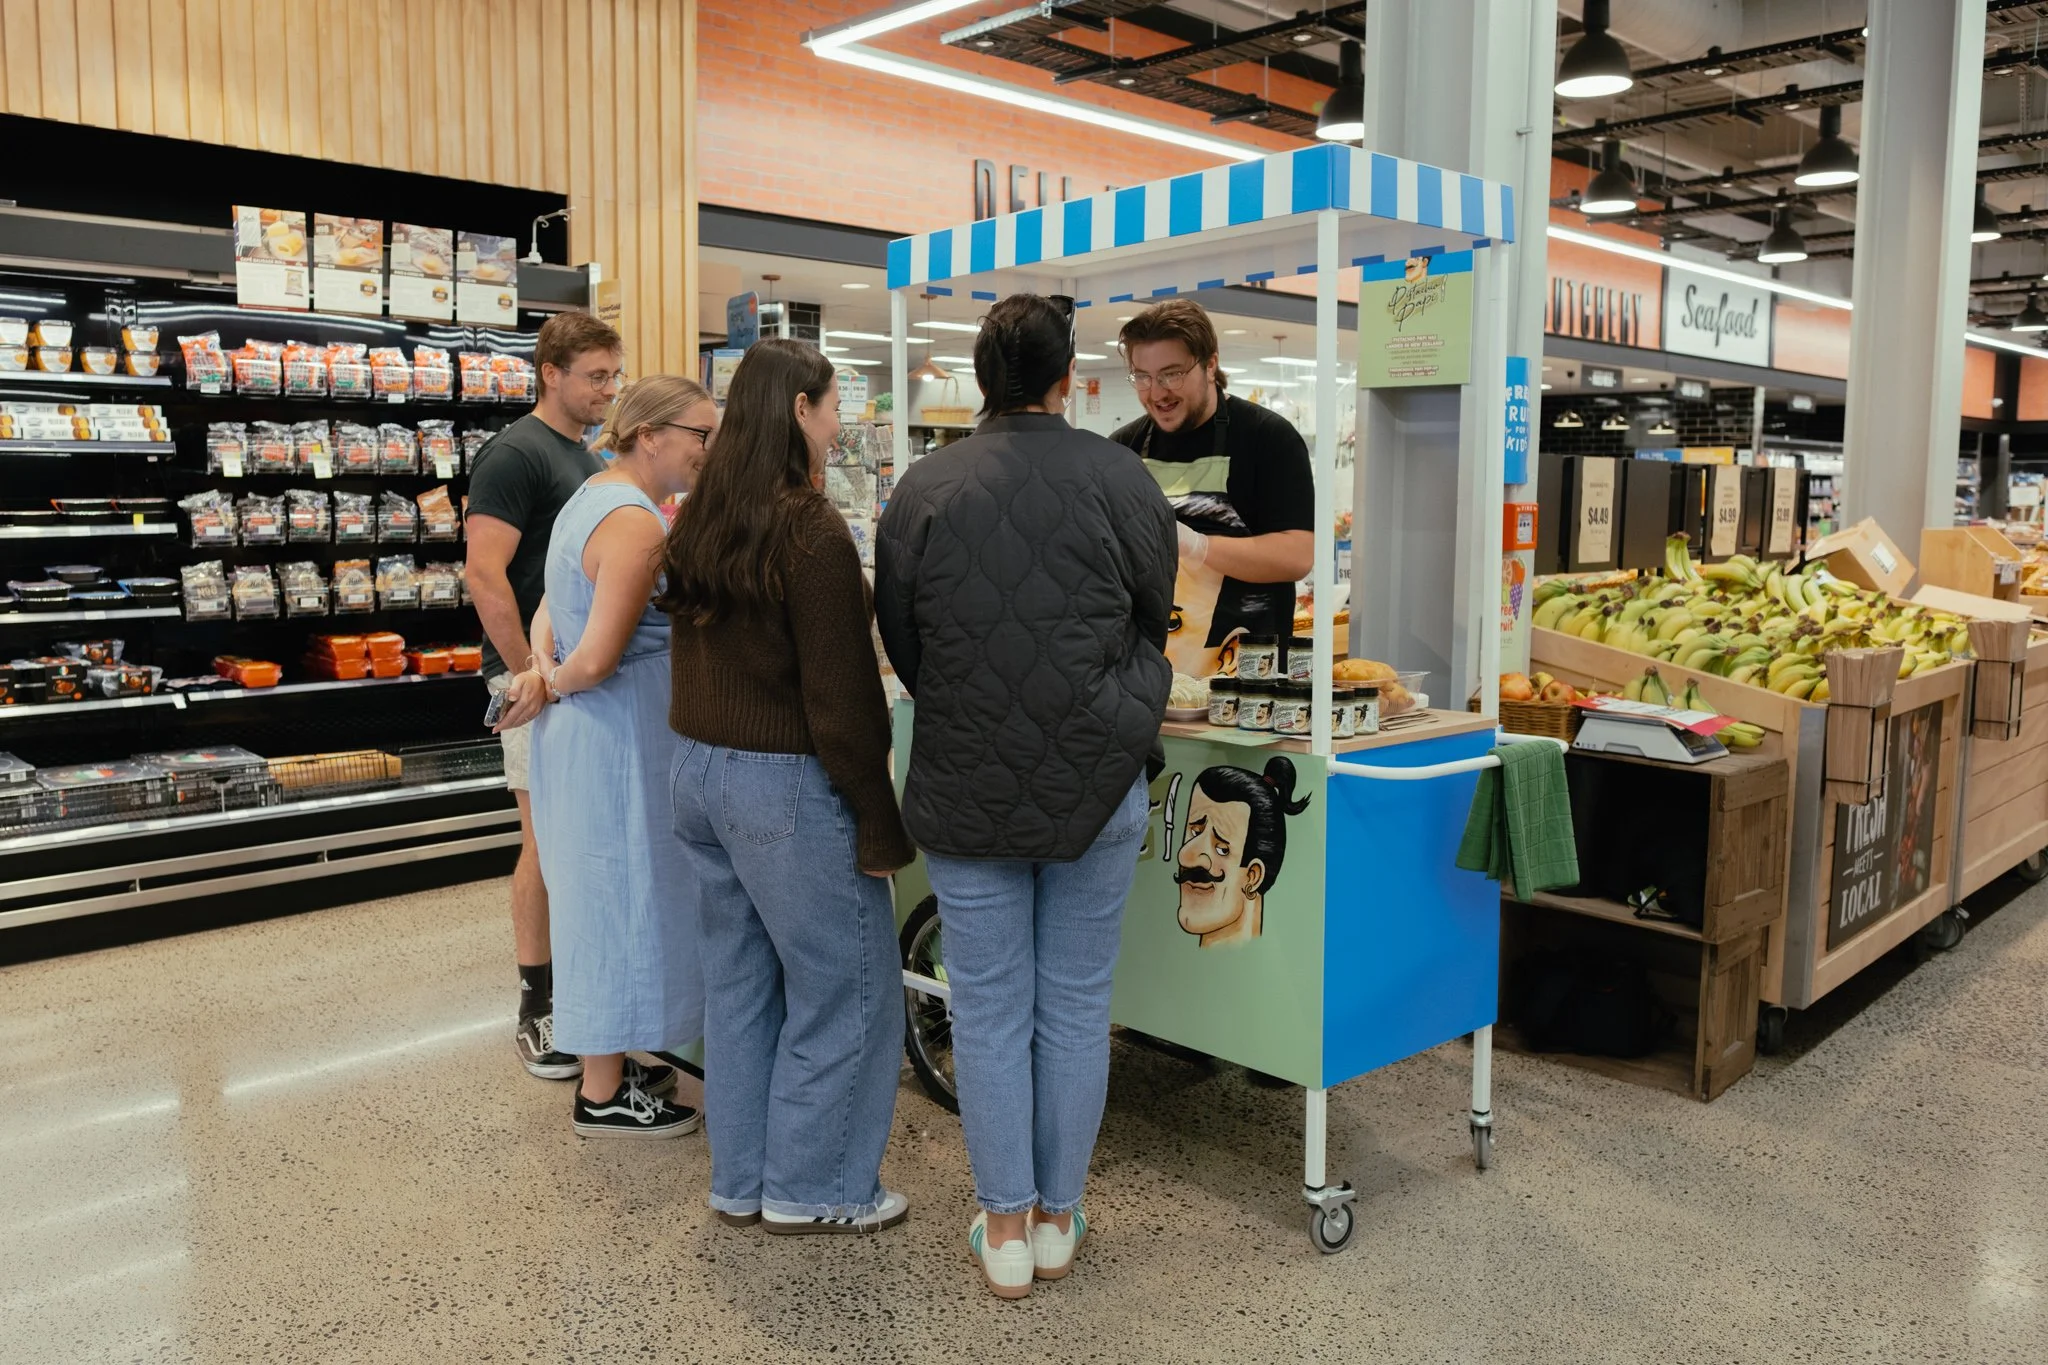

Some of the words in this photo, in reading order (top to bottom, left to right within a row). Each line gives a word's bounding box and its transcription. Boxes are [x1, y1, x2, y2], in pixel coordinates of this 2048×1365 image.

[1388, 277, 1441, 315] Pistachio
[1396, 293, 1437, 332] Papi
[1546, 277, 1642, 346] UTCHERY
[1681, 284, 1758, 347] Seafood
[1588, 506, 1609, 526] $4.49
[1719, 507, 1737, 524] $4.99
[1500, 622, 1514, 634] ruit
[1501, 606, 1513, 616] ree
[1839, 871, 1881, 929] LOCAL
